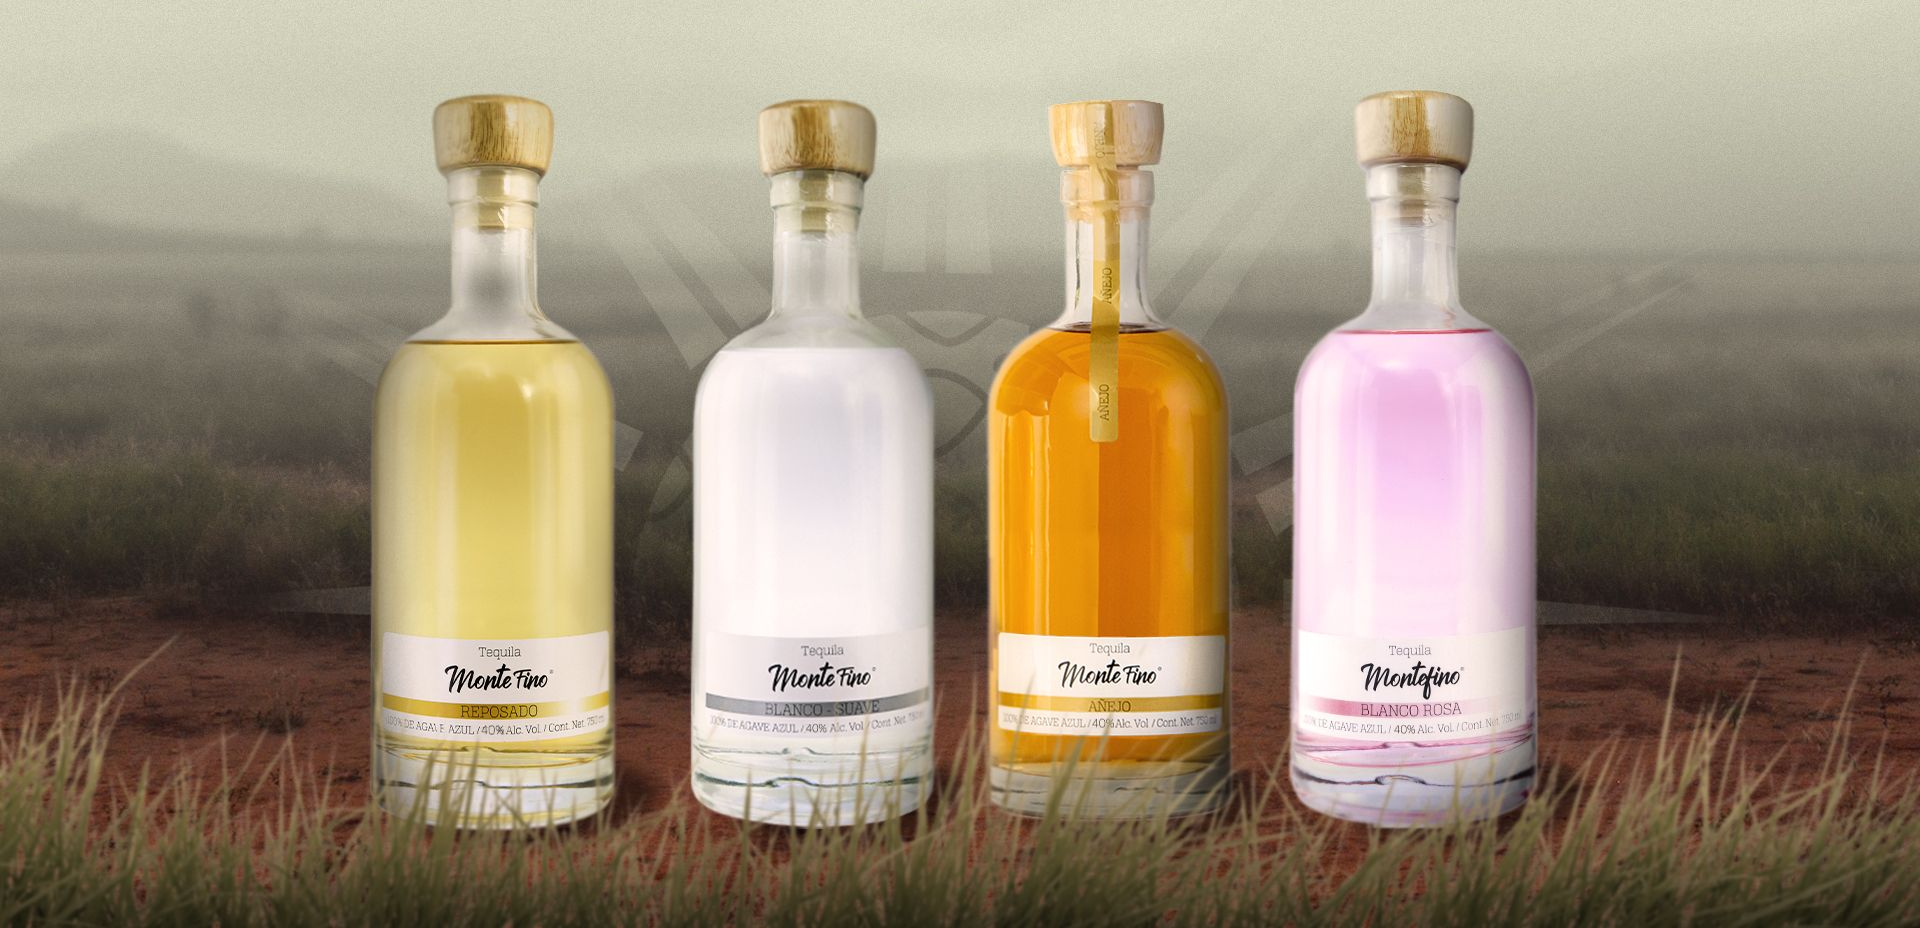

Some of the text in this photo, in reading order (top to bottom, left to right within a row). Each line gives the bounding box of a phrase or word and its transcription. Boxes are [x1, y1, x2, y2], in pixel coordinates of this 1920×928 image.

[1100, 267, 1113, 305] AÑEJO
[1096, 382, 1110, 421] AÑEJO
[478, 646, 521, 661] Tequila
[801, 644, 844, 658] Tequila
[1089, 642, 1130, 656] Tequila
[1389, 644, 1431, 658] Tequila
[445, 663, 548, 693] Monte Fino
[768, 662, 871, 692] Monte Fino
[1058, 659, 1157, 688] Monte Fino
[1361, 661, 1460, 700] Montefino
[460, 705, 538, 718] REPOSADO
[765, 703, 823, 716] BLANCO
[834, 700, 879, 715] SUAVE
[1088, 698, 1131, 712] AÑEJO
[1361, 702, 1462, 717] BLANCO ROSA
[404, 719, 414, 729] DE
[449, 725, 474, 734] AZUL
[481, 725, 504, 735] 40%
[728, 719, 739, 728] DE
[740, 721, 770, 732] AGAVE
[772, 724, 798, 733] AZUL
[806, 724, 827, 732] 40%
[1031, 716, 1059, 726] AGAVE
[1061, 718, 1086, 728] AZUL
[1092, 719, 1114, 728] 40%
[1329, 721, 1358, 732] AGAVE
[1360, 724, 1386, 734] AZUL
[1394, 725, 1415, 734] 40%
